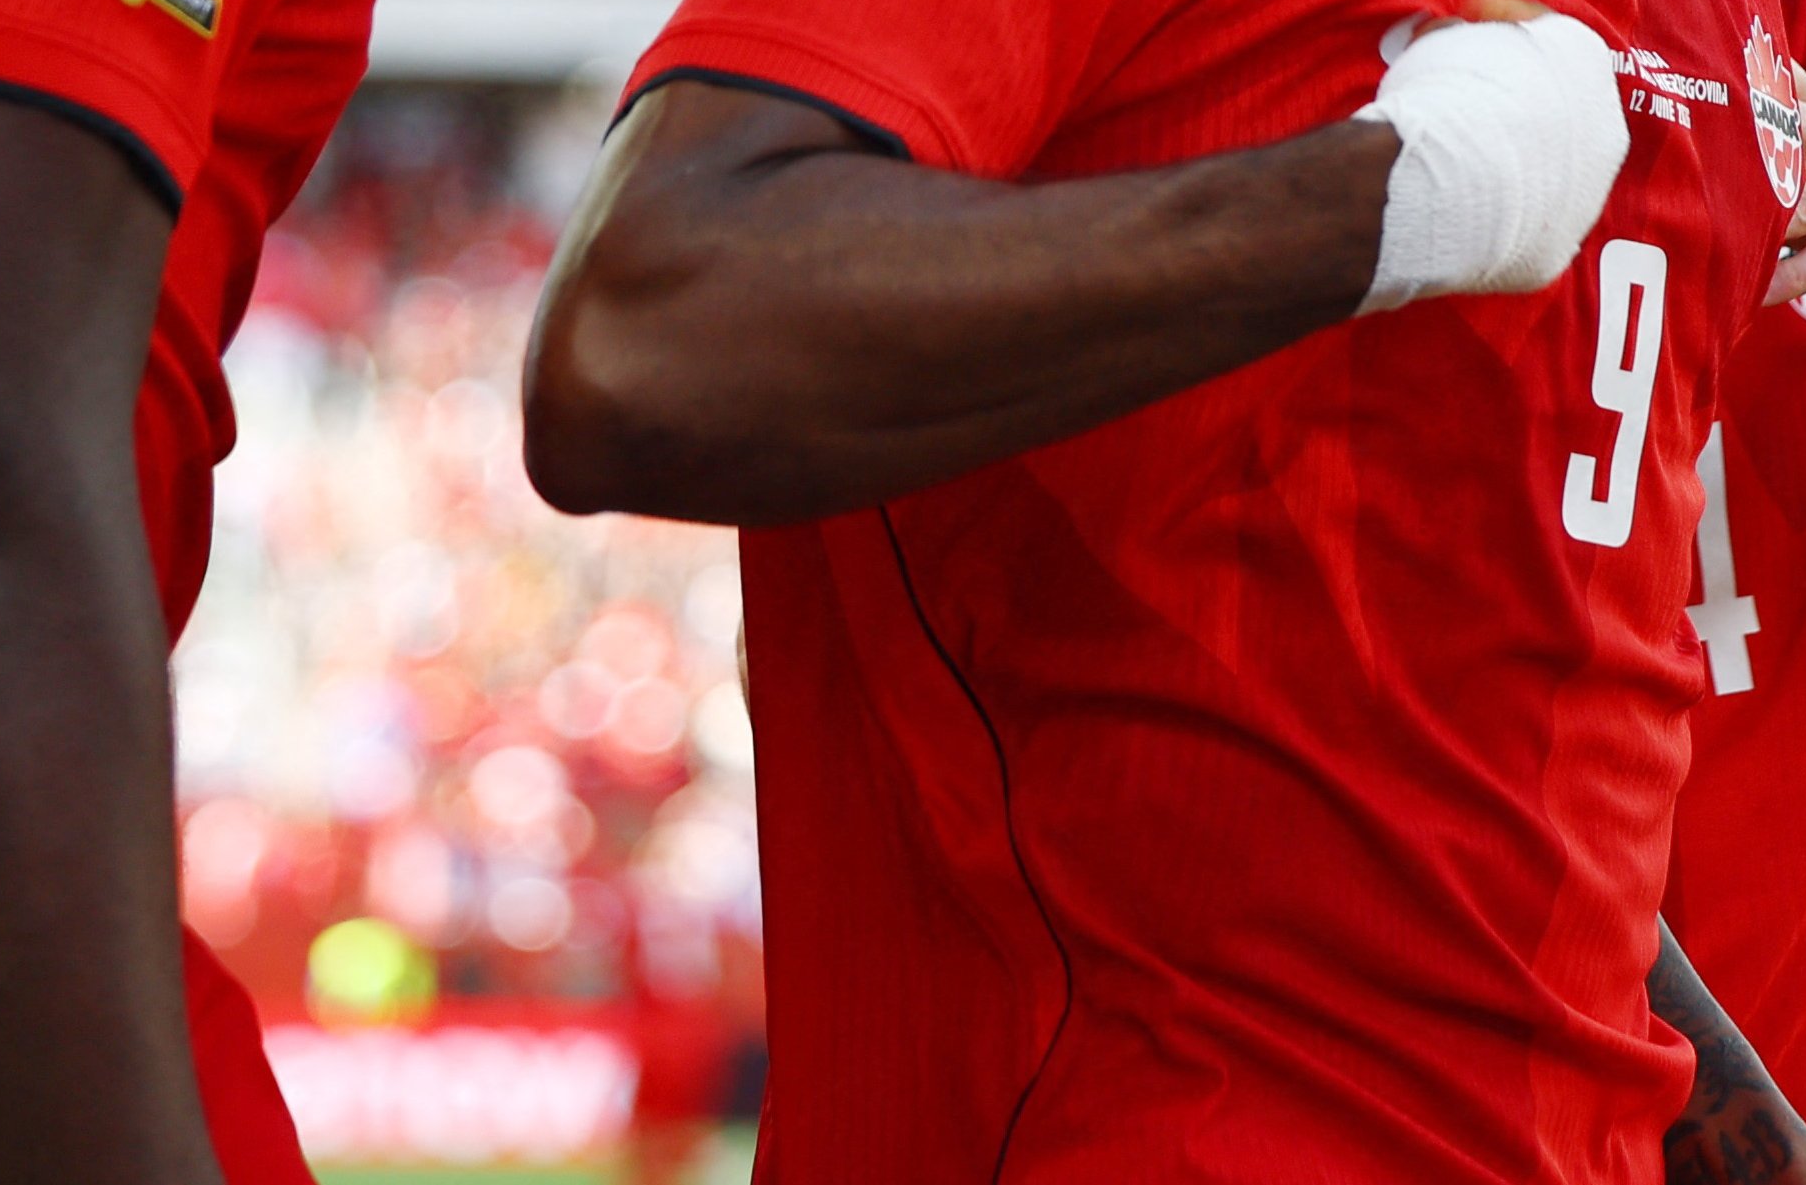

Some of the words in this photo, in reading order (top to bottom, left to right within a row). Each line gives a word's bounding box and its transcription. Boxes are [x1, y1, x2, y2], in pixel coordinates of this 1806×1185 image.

[1629, 88, 1646, 113] 12
[1751, 92, 1800, 142] CANADA
[1561, 238, 1668, 548] 9
